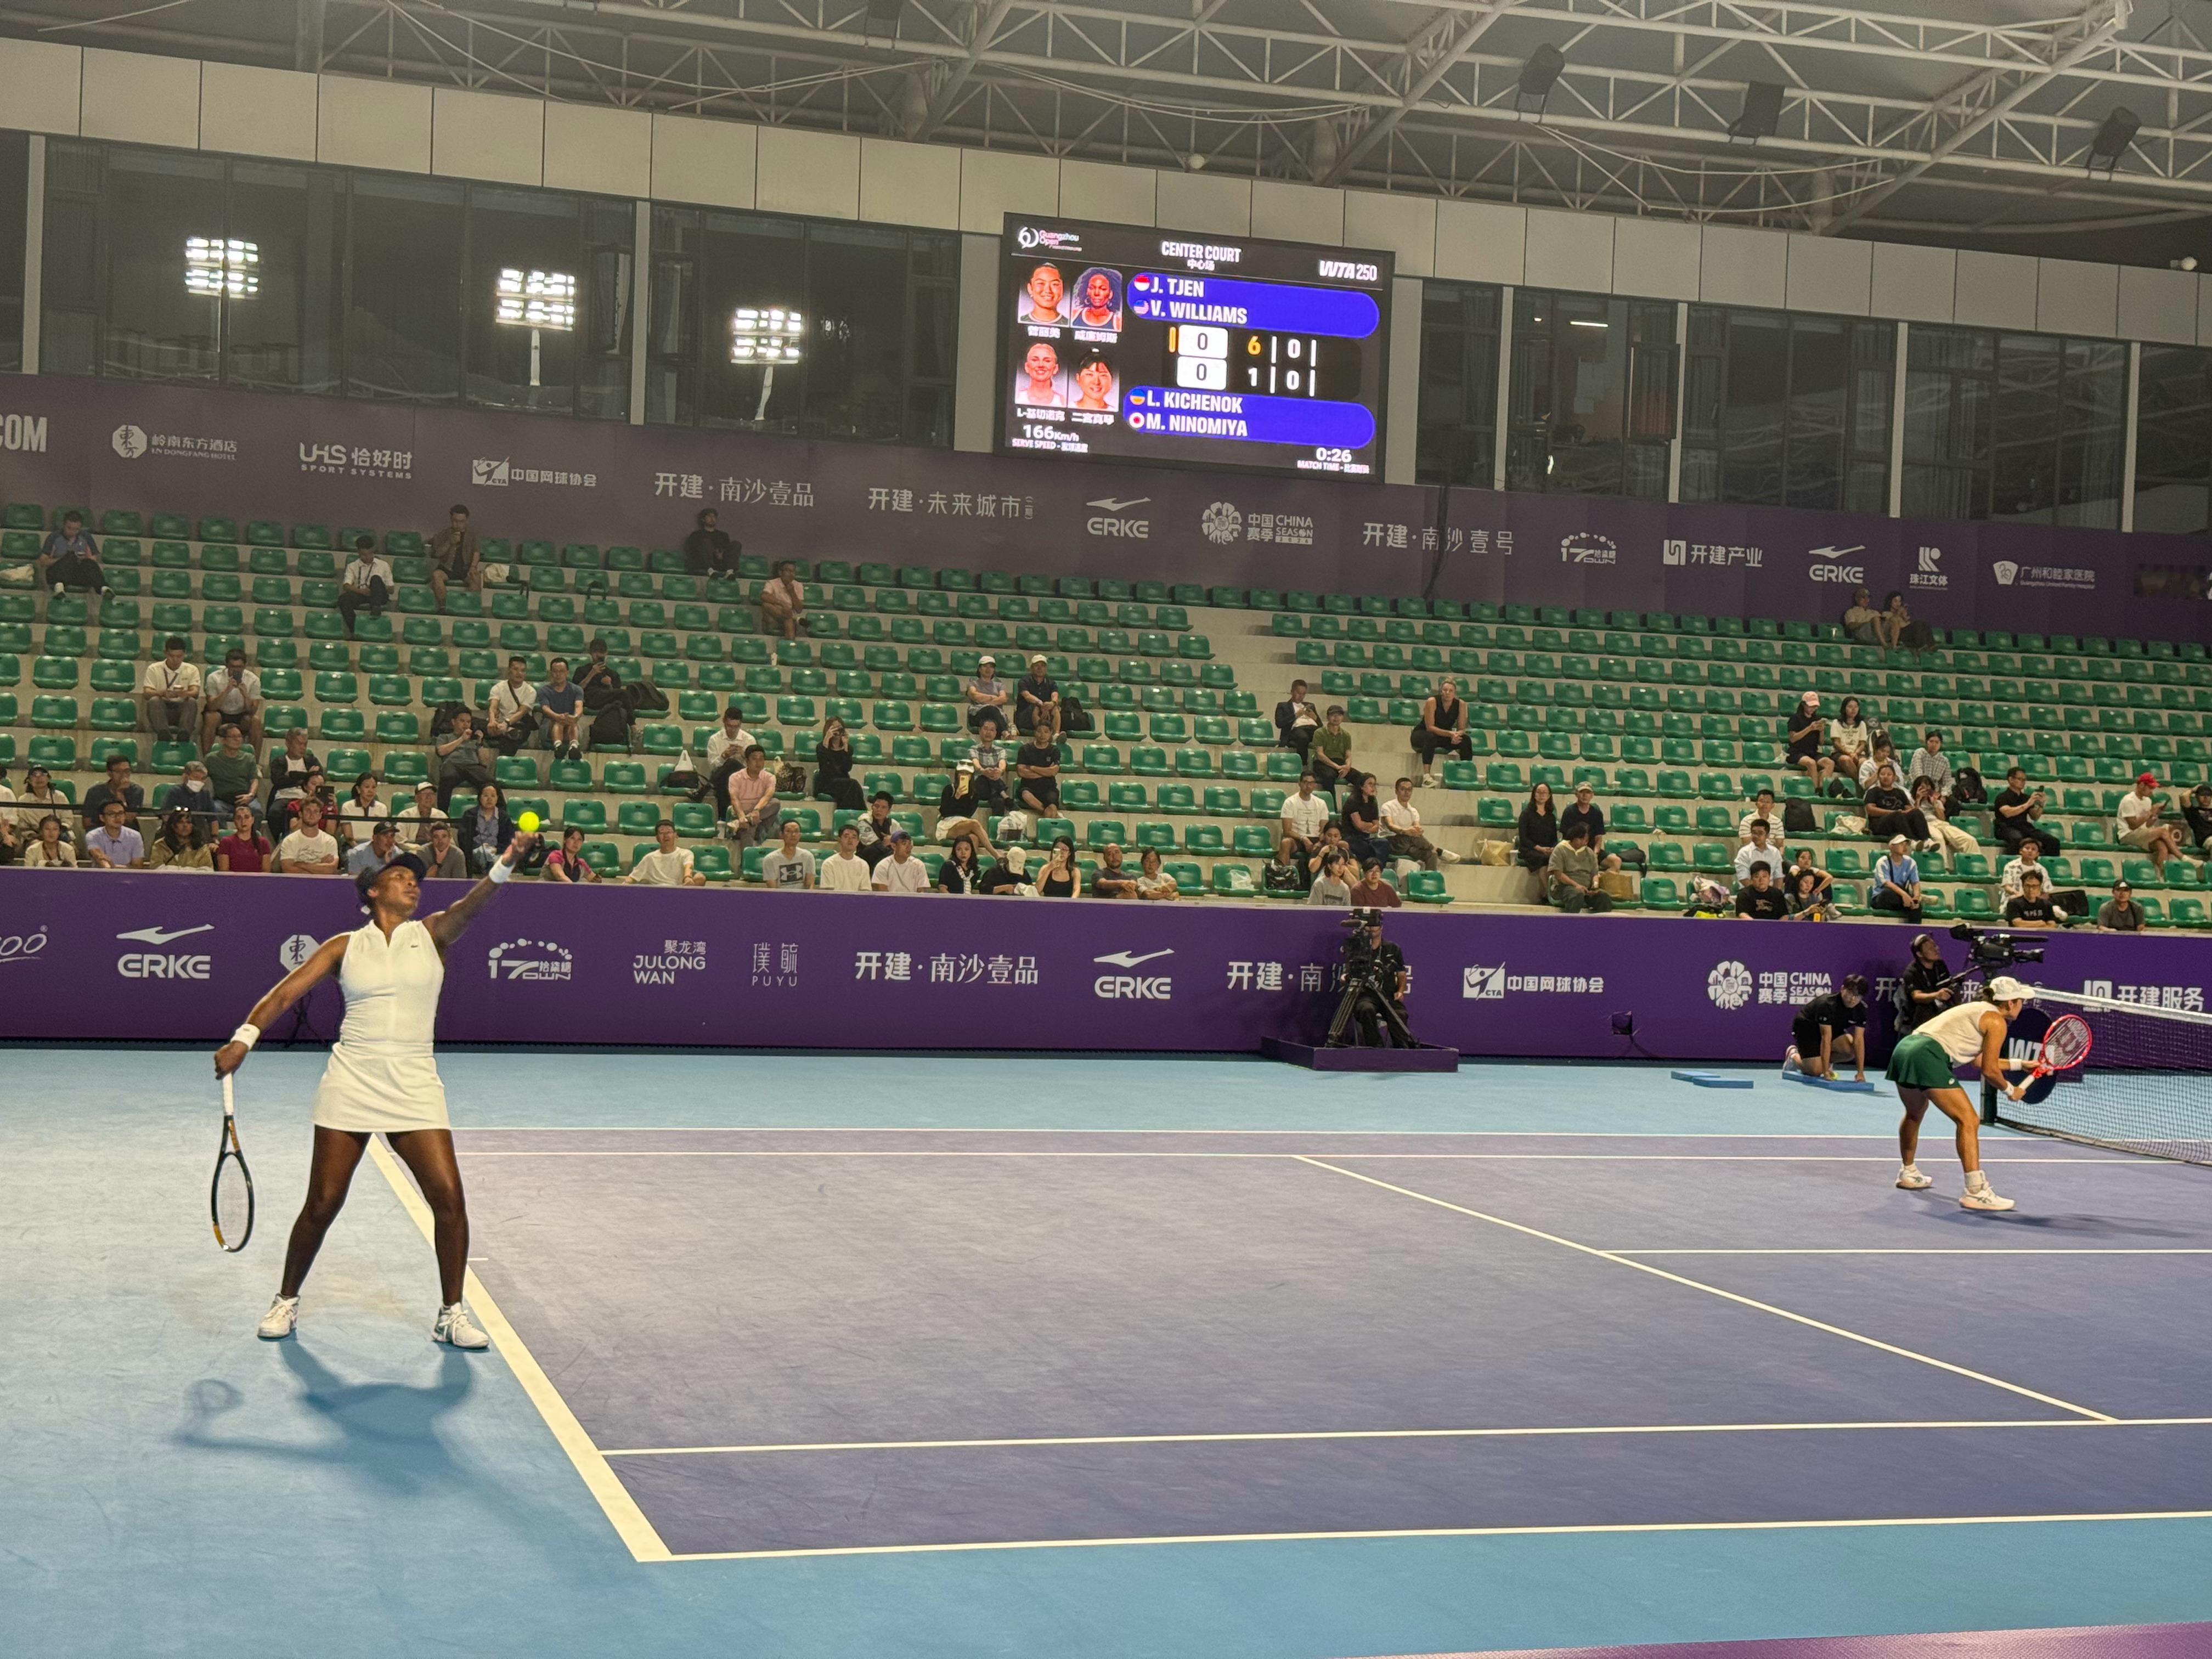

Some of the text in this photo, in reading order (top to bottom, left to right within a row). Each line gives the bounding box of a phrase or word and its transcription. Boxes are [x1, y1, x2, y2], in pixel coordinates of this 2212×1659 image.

[1040, 236, 1059, 246] Open
[1161, 241, 1242, 263] CENTER COURT
[1319, 259, 1378, 281] WTA 250
[1150, 276, 1205, 297] J. TJEN
[1150, 300, 1248, 324] V. WILLIAMS
[1198, 332, 1301, 359] 0 6 0
[1197, 363, 1300, 390] 0 1 0
[1147, 390, 1243, 414] L. KICHENOK
[0, 414, 48, 452] OM
[1146, 413, 1248, 437] M. NINOMIYA
[351, 447, 413, 470] 恰好时
[1316, 447, 1352, 462] 0:26
[301, 464, 412, 479] SPORT SYSTEMS
[1297, 460, 1322, 470] MATCH
[1323, 462, 1340, 471] TIME
[511, 469, 597, 487] 中国网球协会
[1087, 517, 1149, 538] ERKE
[1248, 513, 1274, 528] 中国
[1276, 515, 1313, 528] CHINA
[1691, 545, 1763, 567] 开建产业
[1809, 565, 1864, 584] ERKE
[664, 939, 707, 955] 聚龙湾
[117, 953, 211, 979] ERKE
[633, 955, 706, 970] JULONG
[633, 970, 675, 985] WAN
[752, 975, 798, 986] PUYU
[1507, 975, 1604, 993] 中国网球协会
[1759, 972, 1787, 988] 中国
[1790, 972, 1832, 985] CHINA
[1094, 976, 1172, 1000] ERKE
[1758, 988, 1787, 1004] 赛季
[2117, 985, 2204, 1012] 开建服务
